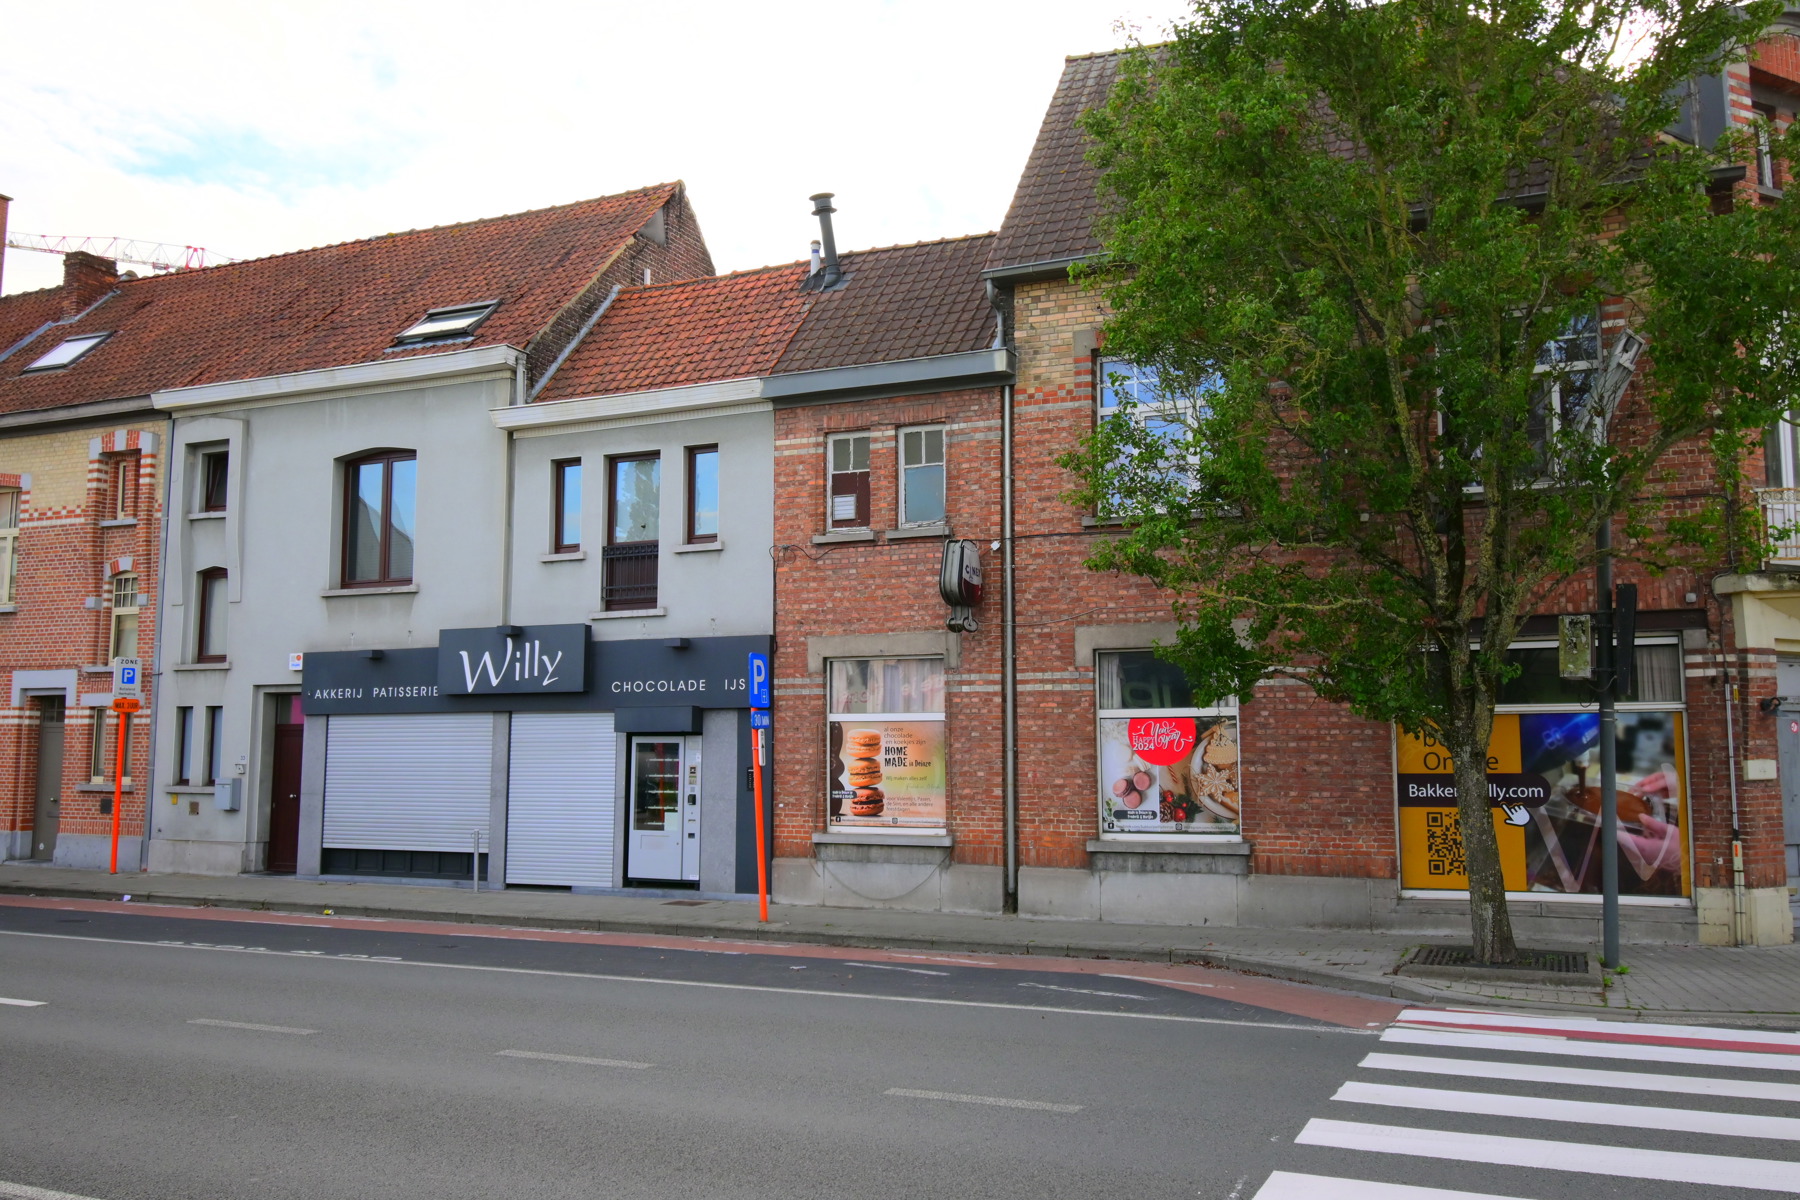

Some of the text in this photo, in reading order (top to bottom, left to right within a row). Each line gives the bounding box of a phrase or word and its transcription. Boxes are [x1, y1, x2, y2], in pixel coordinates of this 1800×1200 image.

[459, 637, 563, 693] Willy
[123, 669, 134, 683] P
[753, 658, 766, 695] P
[611, 678, 746, 693] CHOCOLADE IJS
[308, 686, 439, 700] AKKERIJ PATISSERIE
[884, 746, 908, 756] HOME
[1132, 742, 1155, 750] 2024
[884, 756, 908, 767] MADE
[1423, 752, 1499, 770] One
